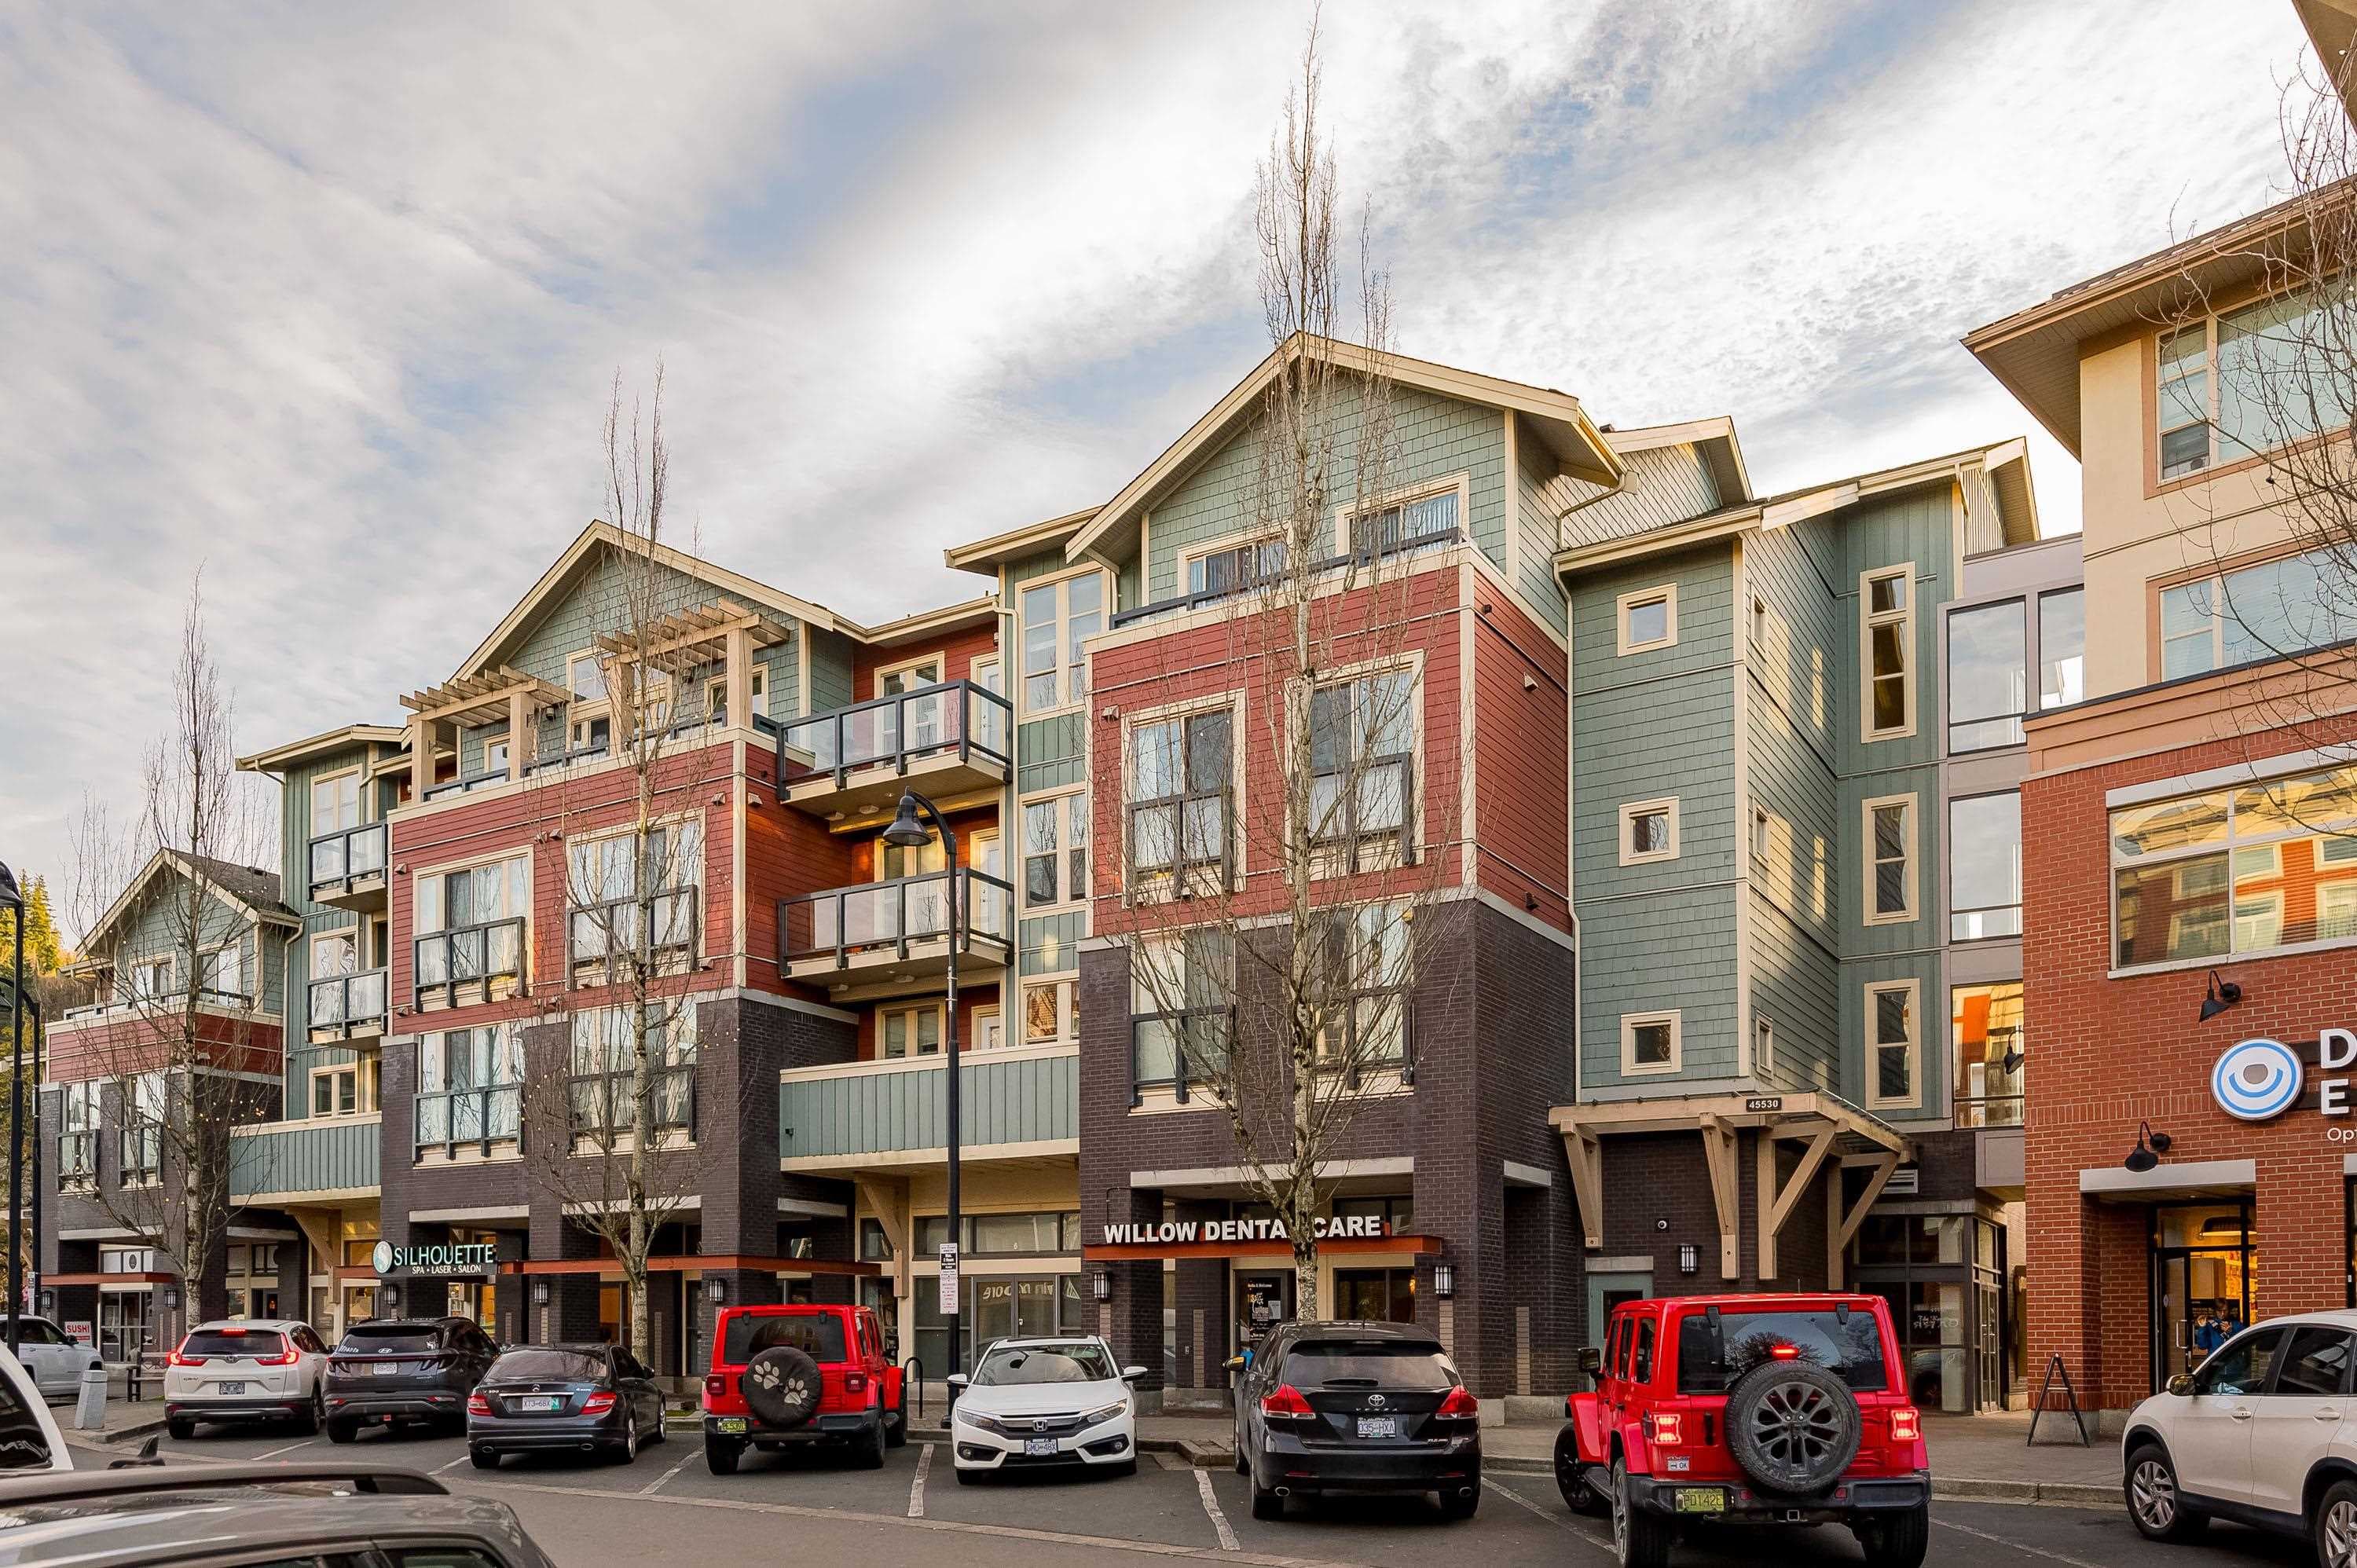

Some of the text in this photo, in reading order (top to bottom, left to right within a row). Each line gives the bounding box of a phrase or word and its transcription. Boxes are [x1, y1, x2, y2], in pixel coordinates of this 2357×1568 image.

[1749, 1100, 1779, 1108] 45530
[1104, 1215, 1382, 1244] WILLOW DENTA CARE
[394, 1244, 495, 1266] SILHOUETTE
[431, 1266, 452, 1274] LASER
[458, 1265, 482, 1273] SALON
[67, 1324, 90, 1334] SUSHI
